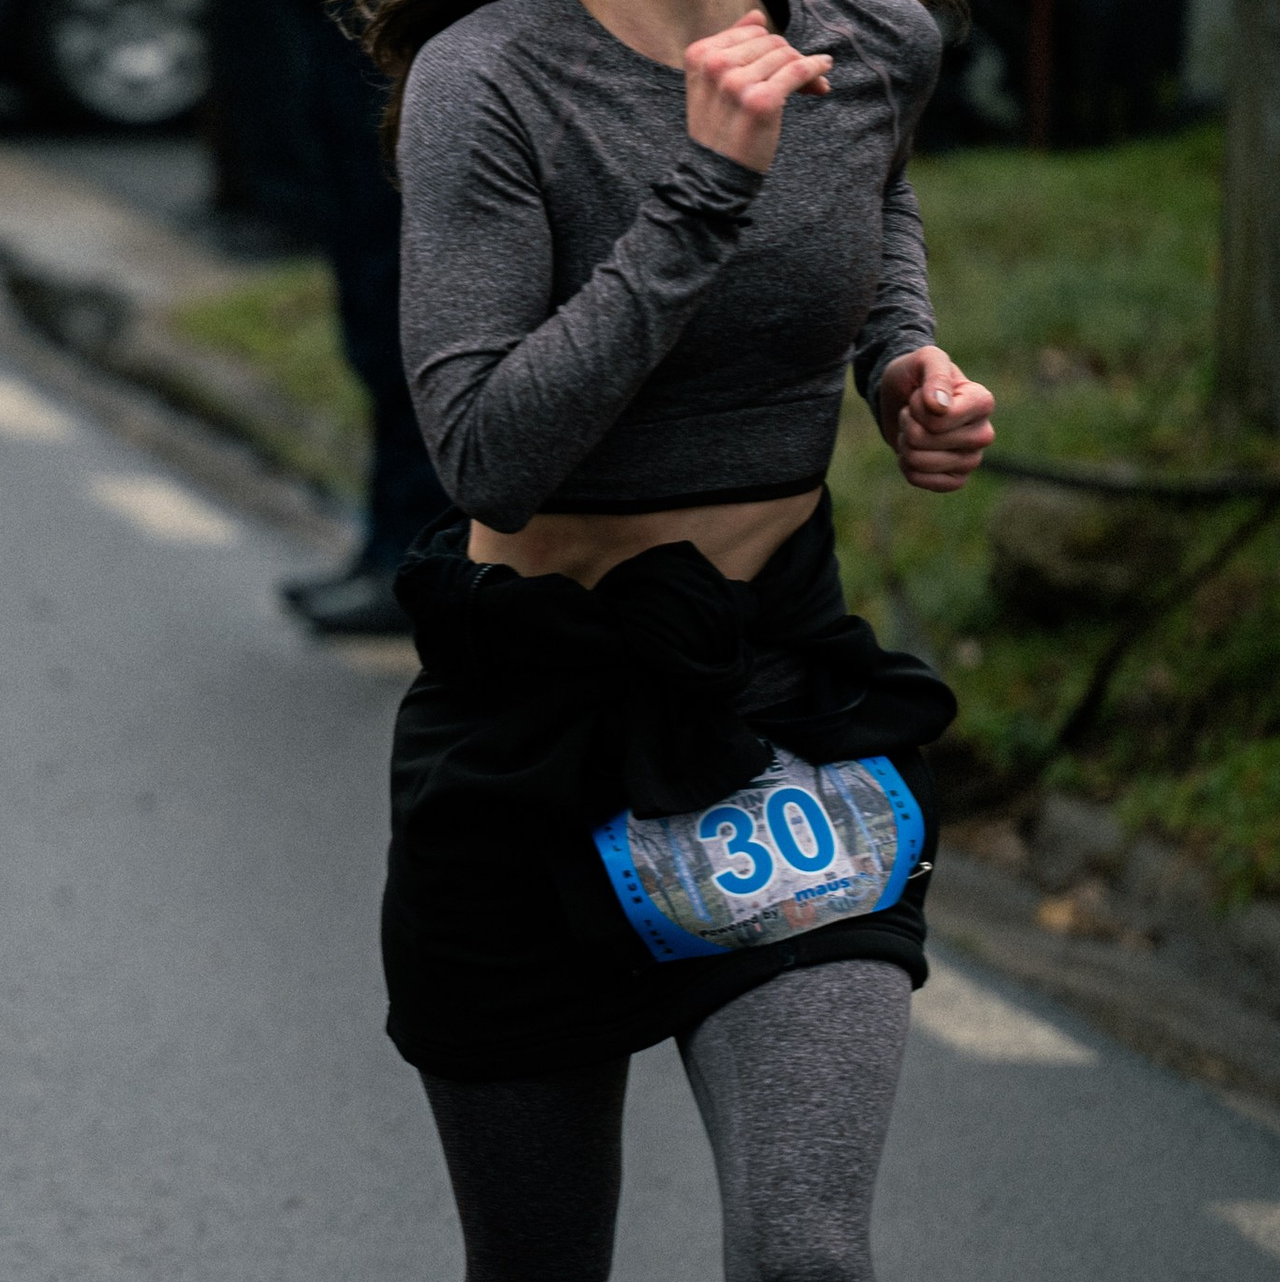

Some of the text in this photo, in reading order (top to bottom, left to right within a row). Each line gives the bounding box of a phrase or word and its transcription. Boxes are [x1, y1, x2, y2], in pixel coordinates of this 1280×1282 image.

[698, 786, 837, 896] 30
[794, 877, 851, 903] maus
[700, 907, 778, 938] Powered by
